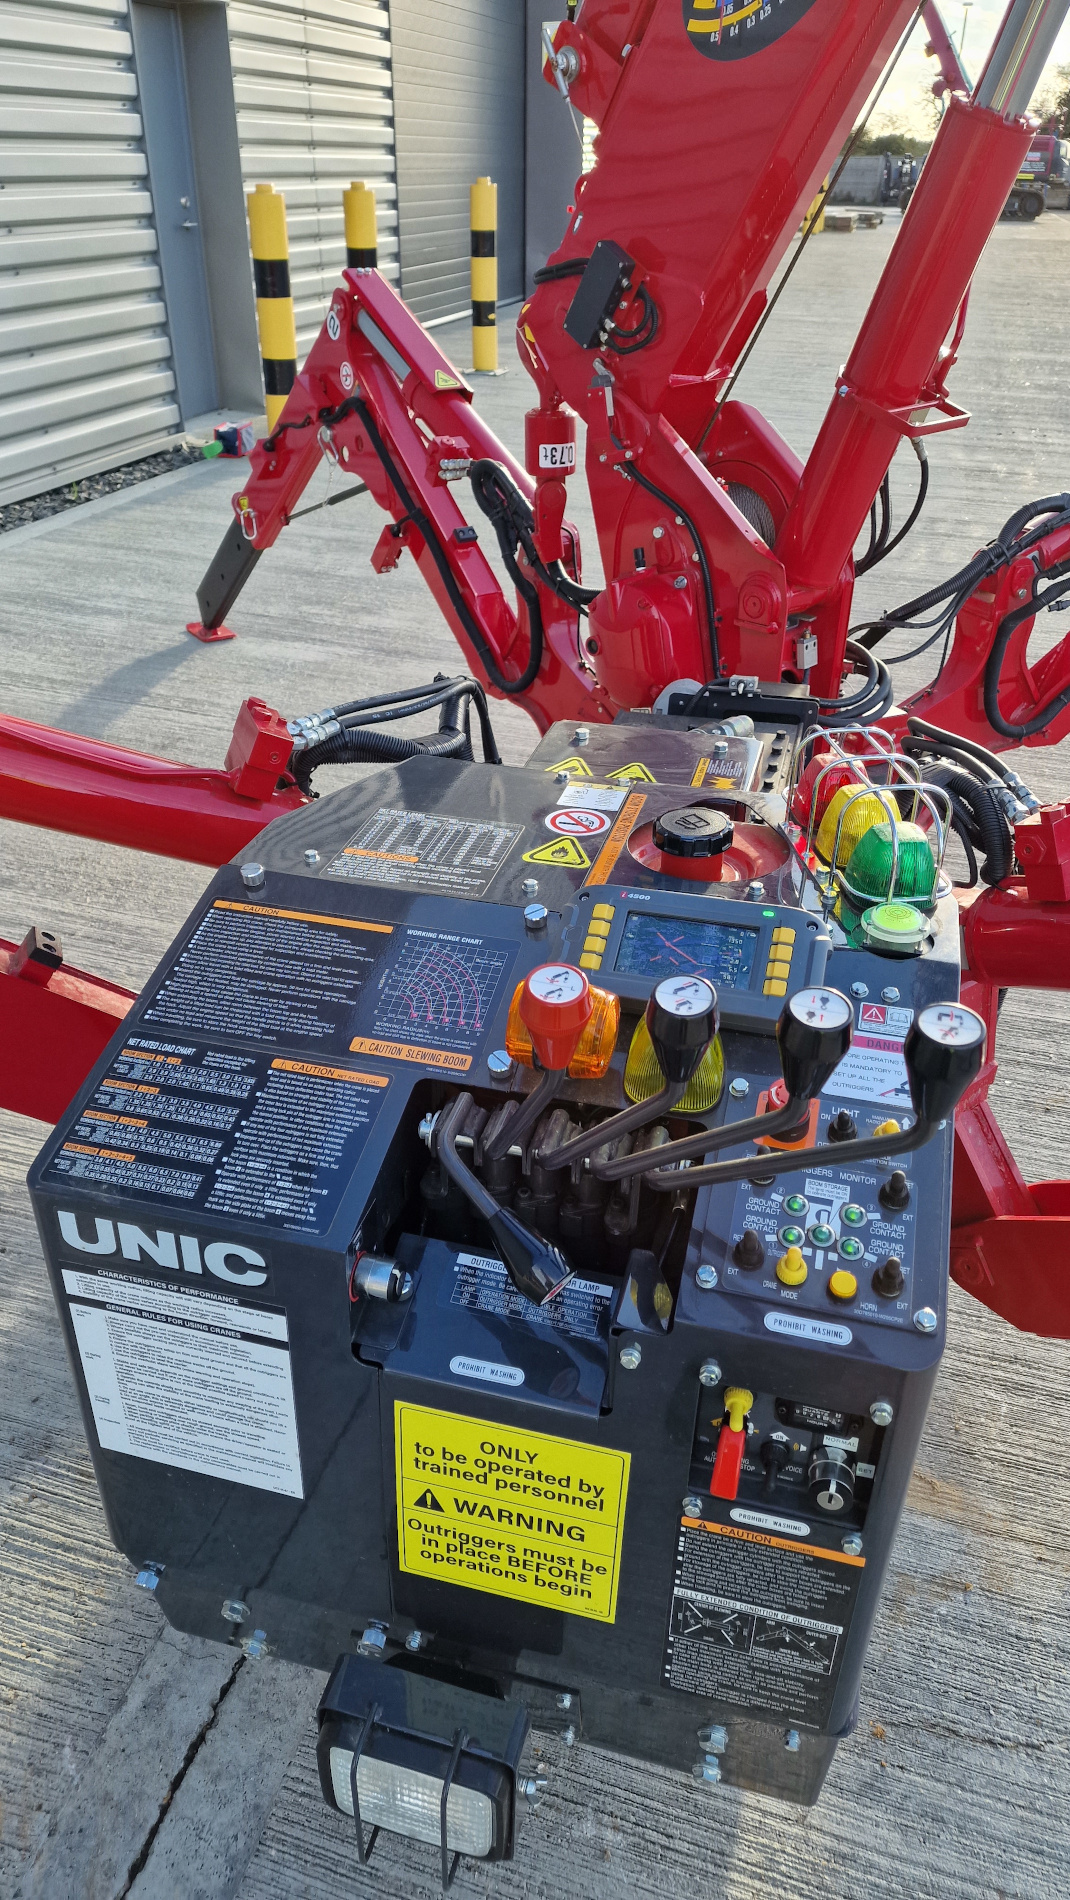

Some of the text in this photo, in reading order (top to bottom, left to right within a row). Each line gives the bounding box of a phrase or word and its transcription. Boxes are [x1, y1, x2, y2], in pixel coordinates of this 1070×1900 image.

[710, 15, 756, 42] 0.5 0.4 0.3
[242, 905, 280, 916] CAUTION
[406, 929, 484, 946] WORKING RANGE CHART
[128, 1038, 196, 1056] NET RATED LOAD CHART
[866, 1040, 904, 1052] DANG
[368, 1043, 468, 1068] CAUTION SLEWING BOOM
[862, 1056, 899, 1066] OPERATING
[291, 1062, 336, 1076] CAUTION
[850, 1064, 891, 1074] MANDATORY
[832, 1082, 874, 1092] OUTRIGGERS
[802, 1168, 876, 1185] IGGERS MONITOR
[824, 1183, 848, 1192] STORAGE
[746, 1204, 781, 1216] CONTACT
[748, 1197, 780, 1208] GROUND
[743, 1222, 778, 1234] CONTACT
[746, 1215, 777, 1226] GROUND
[872, 1221, 905, 1232] GROUND
[870, 1228, 906, 1240] CONTACT
[58, 1211, 268, 1286] UNIC
[869, 1246, 905, 1259] CONTACT
[871, 1239, 903, 1251] GROUND
[471, 1258, 600, 1292] OUTRIGGE LAMP
[728, 1268, 739, 1276] EXT
[98, 1270, 167, 1289] CHARACTERISTICS
[180, 1286, 239, 1305] PERFORMANCE
[457, 1274, 481, 1284] outrigger
[563, 1299, 588, 1309] operating
[763, 1280, 777, 1290] CRANE
[480, 1296, 508, 1308] OUTRIGGER
[570, 1293, 594, 1302] switched
[780, 1290, 798, 1300] MODE
[477, 1303, 494, 1311] CRANE
[526, 1314, 543, 1322] CRANE
[860, 1302, 908, 1311] HORN EXT
[106, 1304, 141, 1316] GENERAL
[142, 1312, 166, 1321] RULES
[184, 1321, 208, 1331] USING
[210, 1326, 241, 1339] CRANES
[774, 1318, 843, 1340] PROHIBIT WASHING
[458, 1362, 517, 1381] PROHIBIT WASHING
[825, 1436, 856, 1447] NORMAL
[480, 1442, 539, 1465] ONLY
[414, 1442, 605, 1499] to be operated by
[786, 1465, 802, 1473] VOICE
[413, 1457, 604, 1512] trained personnel
[452, 1497, 586, 1542] WARNING
[738, 1513, 802, 1532] PROHIBIT WASHING
[407, 1518, 607, 1575] Outriggers must be
[720, 1526, 814, 1554] CAUTION OUTRIGGERS
[421, 1534, 592, 1586] in place BEFORE
[420, 1550, 592, 1599] operations begin
[676, 1589, 840, 1632] FULLY EXTENDED CONDITION OF OUTRIGGERS
